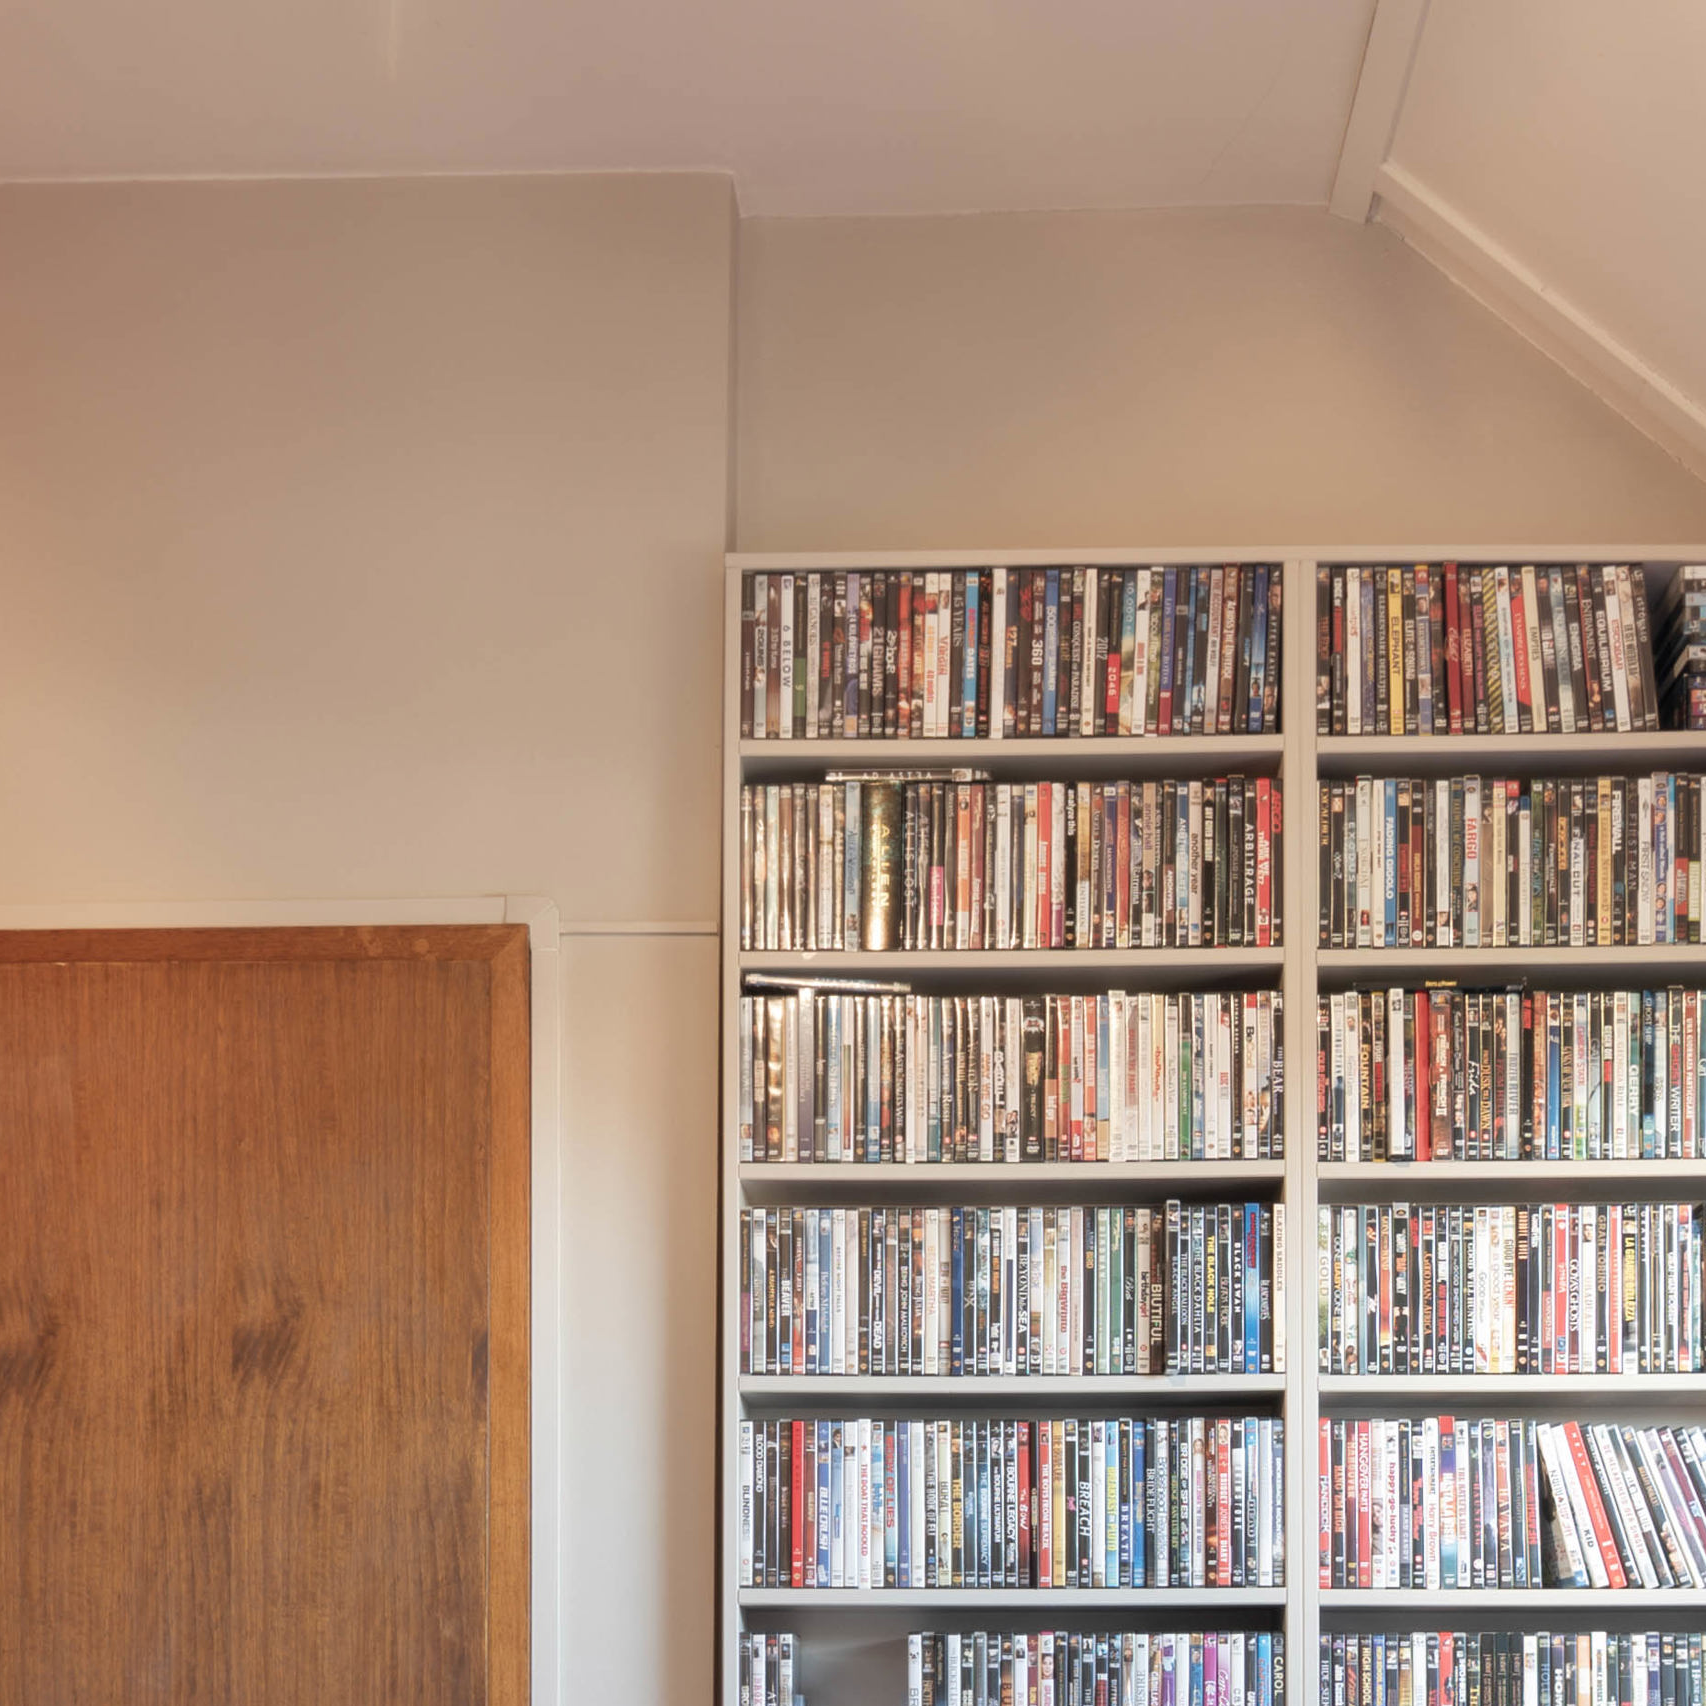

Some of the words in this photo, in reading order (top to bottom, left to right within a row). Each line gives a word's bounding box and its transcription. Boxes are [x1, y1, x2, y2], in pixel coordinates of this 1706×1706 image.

[953, 594, 963, 608] 45
[953, 610, 964, 647] YEARS
[1006, 625, 1017, 646] 127
[1405, 620, 1414, 643] ELITE
[1530, 626, 1540, 661] EMPTIES
[1032, 639, 1043, 665] 360
[1096, 637, 1108, 660] 2012
[1391, 616, 1400, 676] ELEPHANT
[1463, 628, 1472, 676] ELIZABETH
[1570, 623, 1581, 671] ENIGMA
[1596, 611, 1612, 692] EQUILIBRIUM
[782, 641, 792, 688] BELOW
[1108, 666, 1117, 697] 2046
[1406, 651, 1415, 680] SQUAD
[1066, 789, 1077, 820] analyze
[1067, 821, 1077, 835] this
[1466, 818, 1478, 859] FARGO
[1612, 790, 1622, 854] FIREWALL
[879, 824, 890, 907] ALIEN
[1189, 833, 1200, 870] another
[1245, 823, 1254, 905] ARBITRAGE
[1189, 873, 1199, 894] year
[1272, 1060, 1284, 1093] BEAR
[1361, 1043, 1371, 1109] FOUNTAIN
[1467, 1060, 1480, 1096] Frida
[1630, 1064, 1640, 1116] GERRY
[1207, 1236, 1215, 1253] THE
[1597, 1214, 1606, 1245] GRAN
[1207, 1255, 1215, 1284] BLACK
[1234, 1242, 1242, 1276] BLACK
[1597, 1249, 1607, 1292] TORINO
[781, 1280, 791, 1317] BEAVER
[873, 1269, 882, 1295] DEVIL
[1234, 1282, 1242, 1313] SWAN
[1206, 1287, 1215, 1313] HOLE
[873, 1320, 883, 1348] DEAD
[1359, 1433, 1369, 1489] HANGOVER
[952, 1478, 962, 1499] THE
[1146, 1468, 1156, 1496] BRIDE
[1079, 1481, 1091, 1536] BREACH
[1146, 1499, 1156, 1533] FLIGHT
[1319, 1475, 1329, 1533] HANCOCK
[1499, 1488, 1510, 1552] HAVANA
[952, 1502, 962, 1548] BORDER
[1121, 1505, 1129, 1560] BREATH
[1274, 1656, 1284, 1696] CAROL
[1362, 1647, 1371, 1671] HIGH
[1362, 1673, 1371, 1704] SCHOOL
